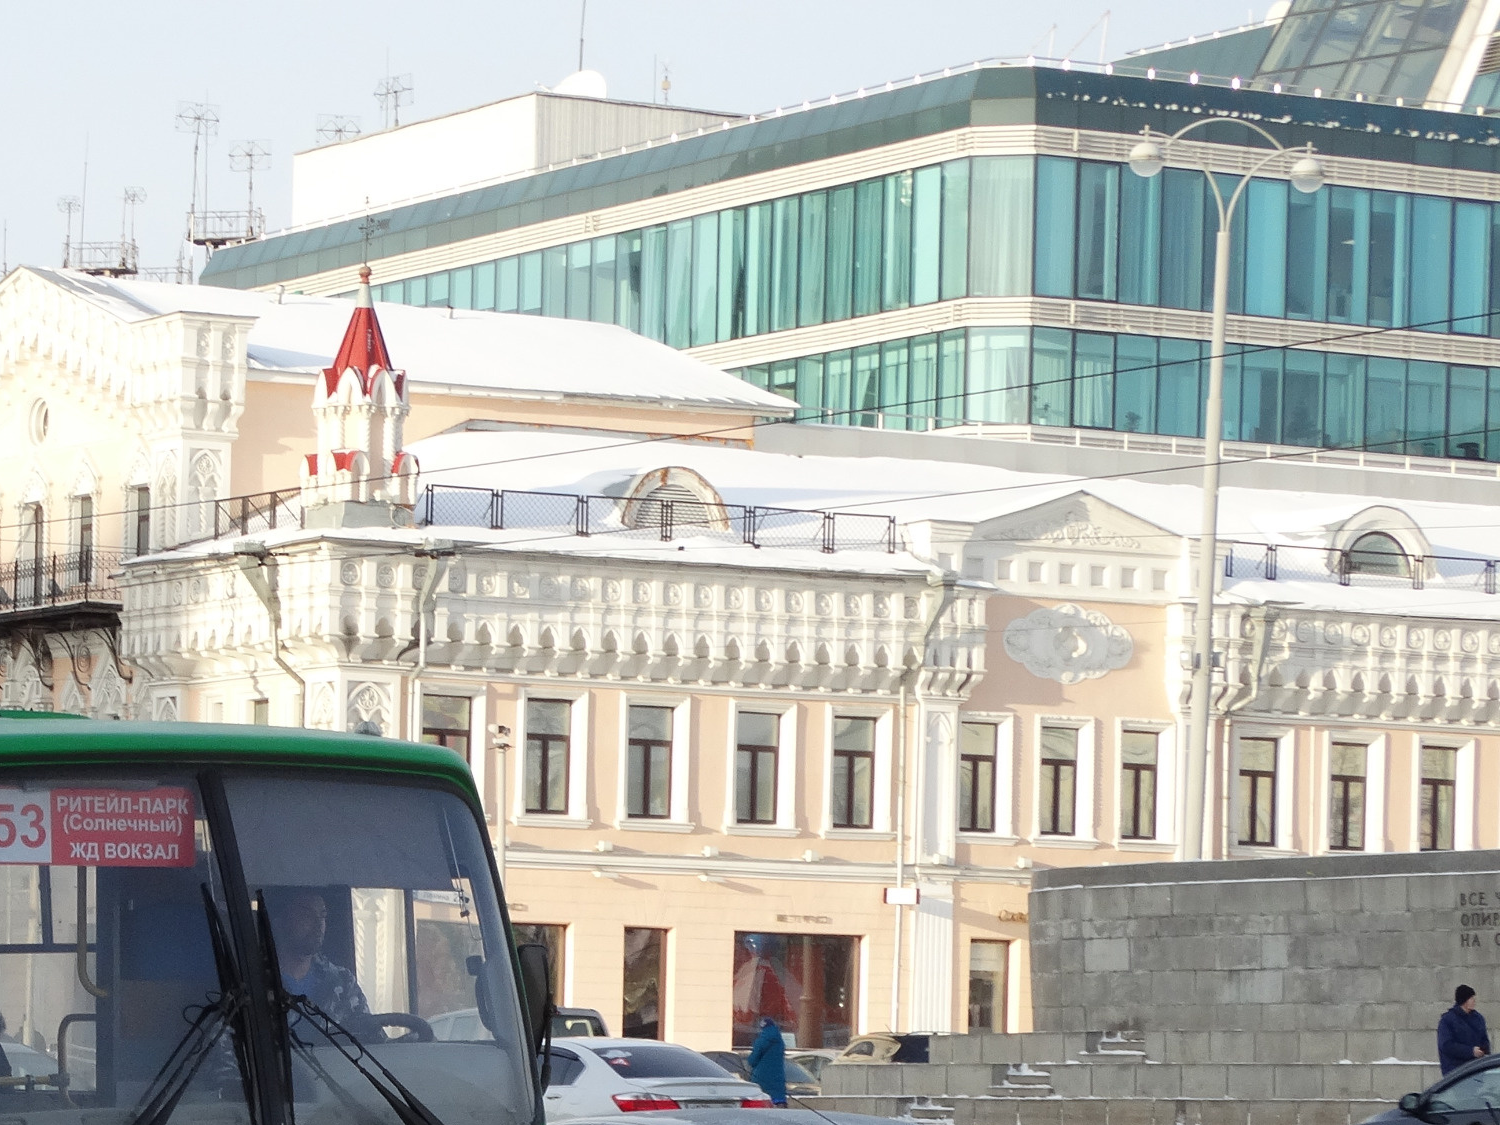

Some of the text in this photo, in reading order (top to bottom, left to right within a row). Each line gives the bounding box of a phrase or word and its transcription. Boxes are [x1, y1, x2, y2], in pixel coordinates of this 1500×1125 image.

[56, 793, 189, 815] РИТЕЙЛ-ПАРК
[62, 814, 183, 836] (Солнечный)
[69, 842, 179, 861] ЖД ВОКЗАЛ
[1459, 891, 1488, 906] ВСЕ
[1460, 932, 1481, 948] НА
